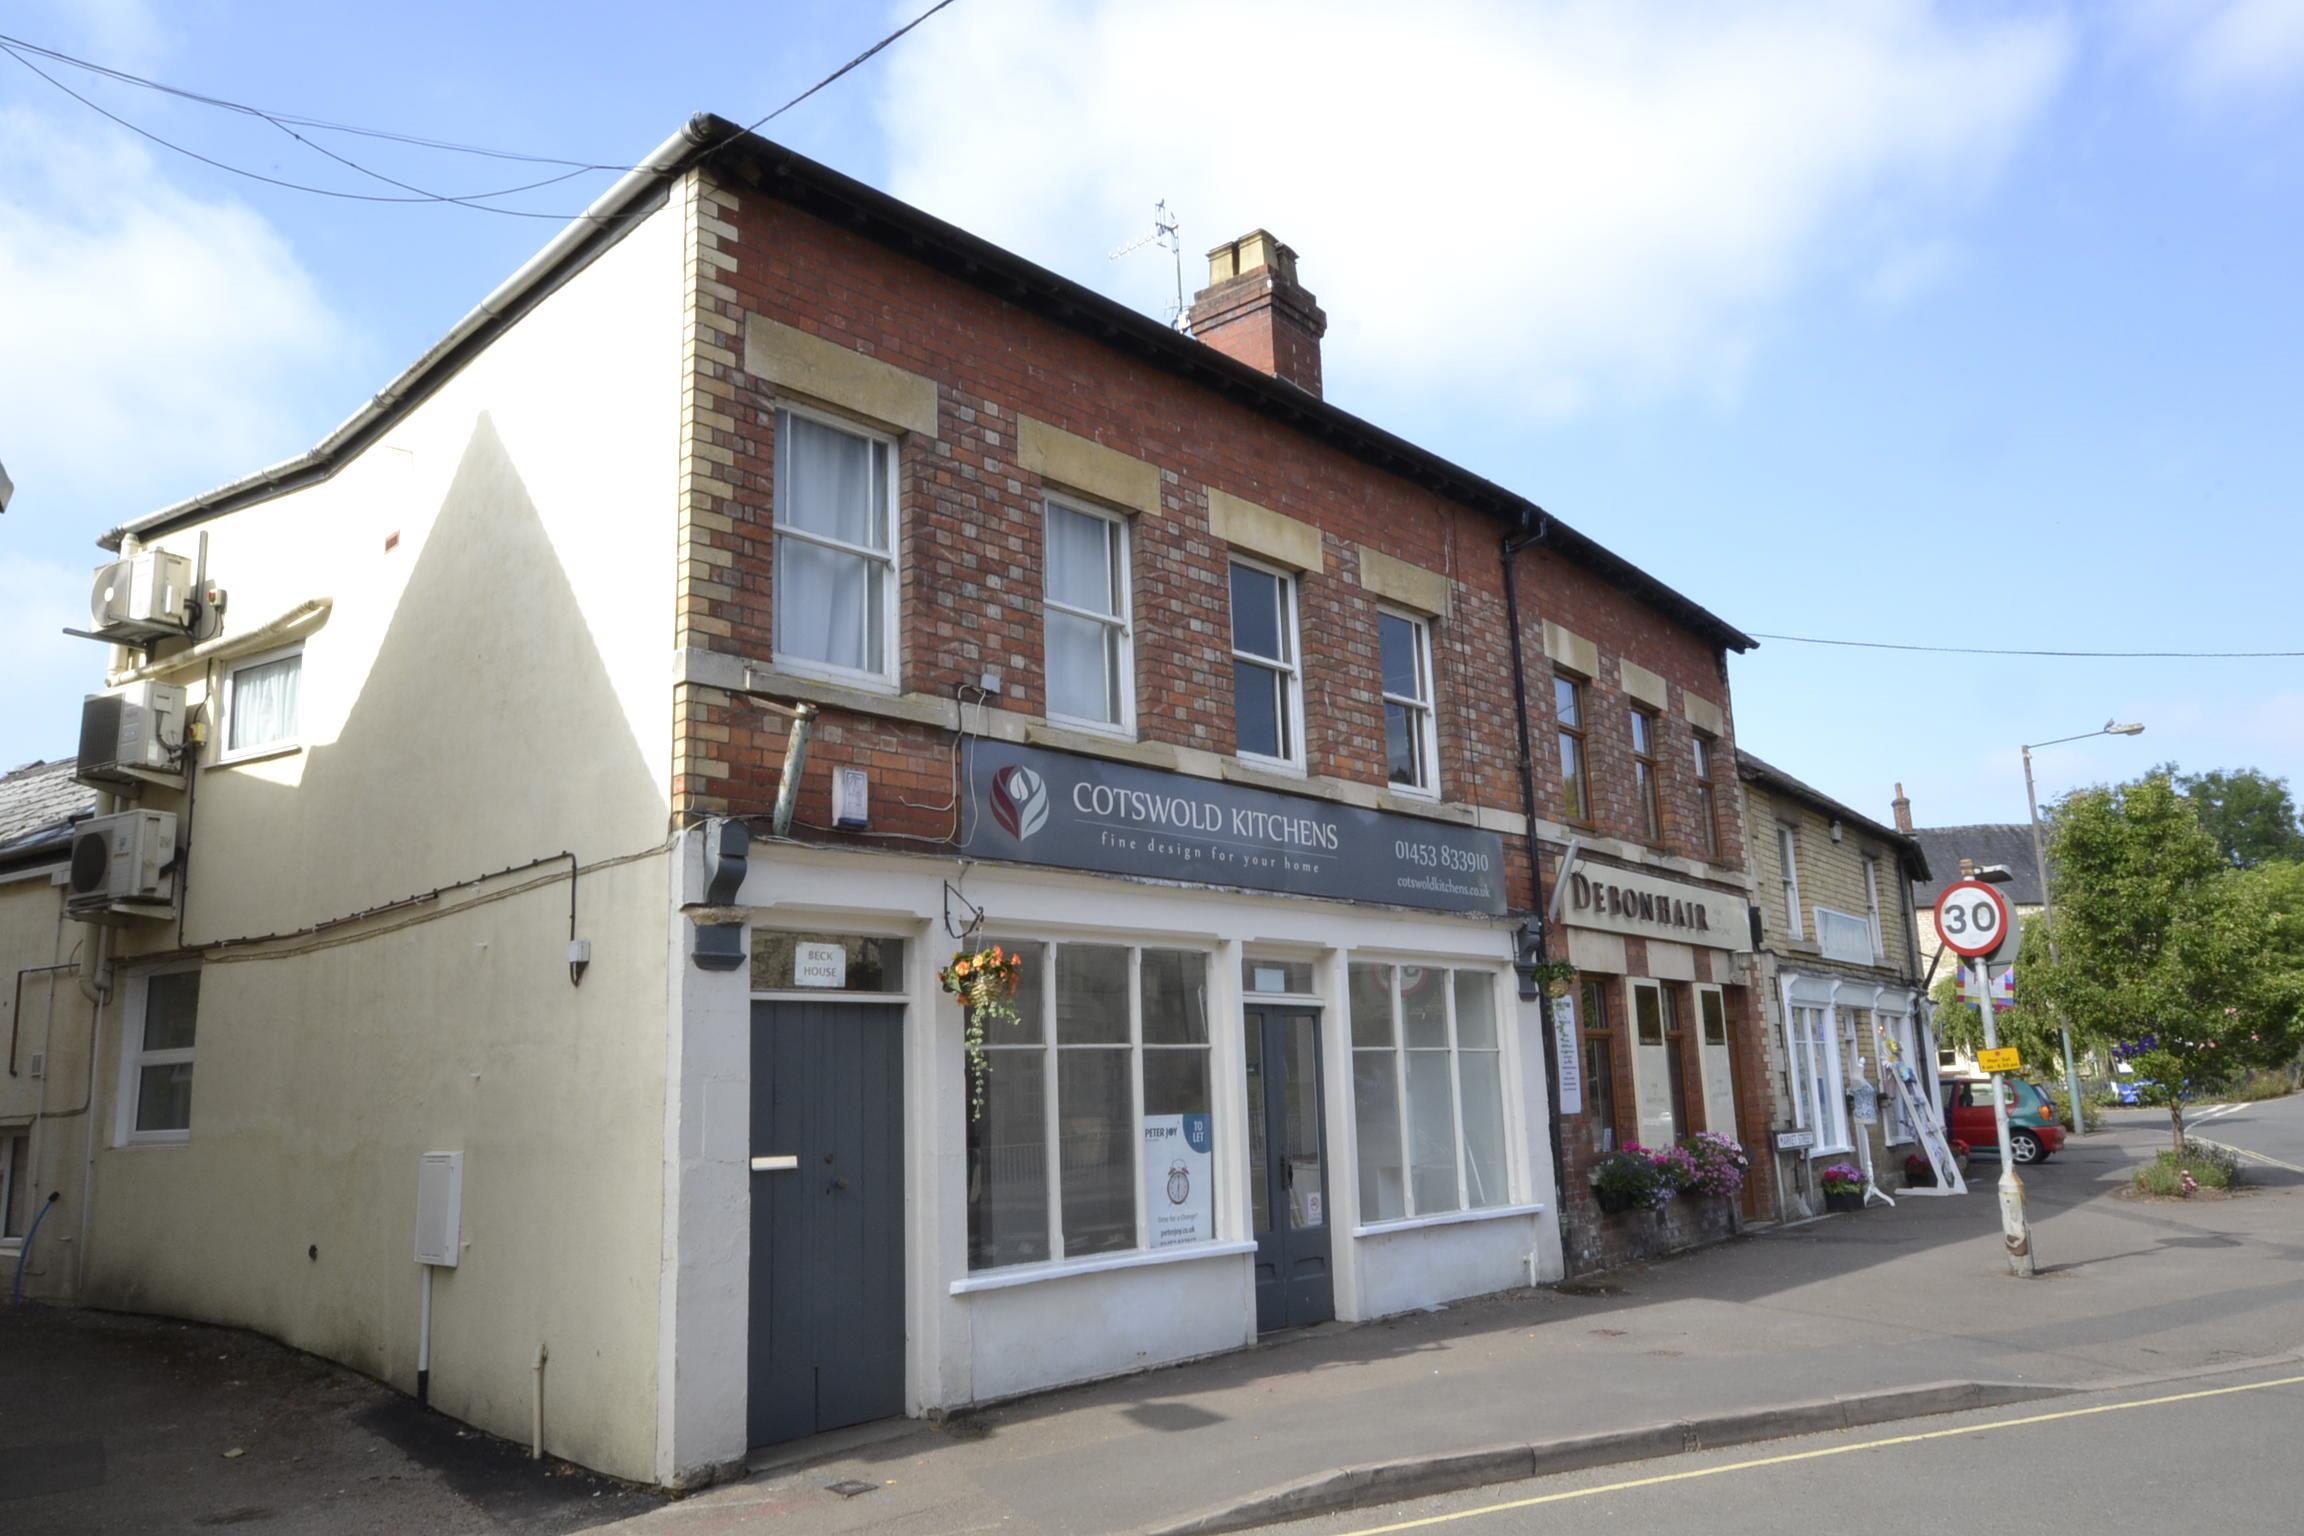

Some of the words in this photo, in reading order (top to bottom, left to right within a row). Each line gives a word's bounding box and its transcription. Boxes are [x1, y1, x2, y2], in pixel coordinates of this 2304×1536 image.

[1073, 782, 1222, 832] COTSWOLD
[1231, 808, 1339, 850] KITCHENS
[1101, 831, 1136, 850] fine
[1147, 838, 1201, 860] design
[1211, 846, 1234, 861] for
[1243, 855, 1276, 868] your
[1284, 856, 1319, 873] home
[1395, 840, 1437, 867] 01453
[1441, 845, 1489, 872] 833910
[1397, 876, 1490, 897] cotswoldkitchens.co.uk
[1944, 901, 1996, 934] 30
[808, 950, 833, 961] BECK
[803, 966, 837, 977] HOUSE
[1193, 1120, 1203, 1131] TO
[1145, 1128, 1165, 1138] PETER
[1166, 1127, 1178, 1139] JOY
[1192, 1132, 1204, 1143] LET
[1780, 1135, 1796, 1145] MARKET
[1798, 1134, 1812, 1144] STREET
